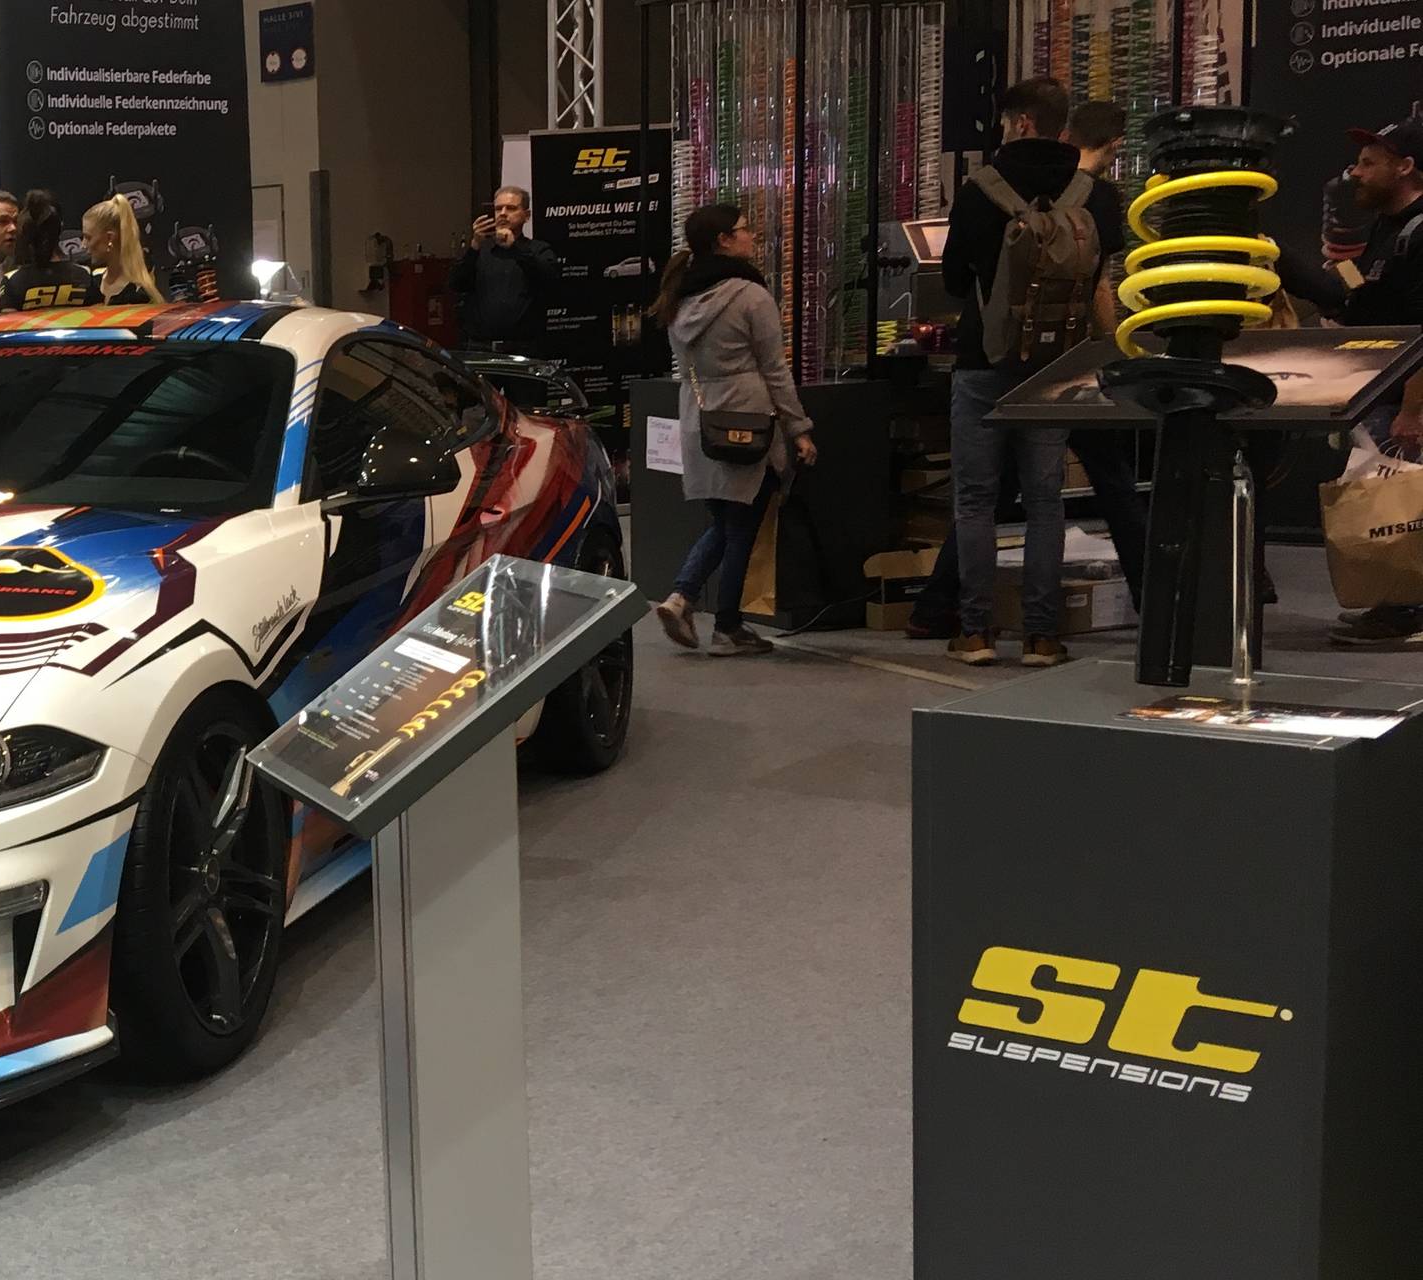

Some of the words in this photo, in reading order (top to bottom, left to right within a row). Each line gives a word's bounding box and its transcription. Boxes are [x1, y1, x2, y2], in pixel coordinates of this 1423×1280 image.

[50, 4, 116, 32] Fahrzeug
[121, 8, 199, 33] abgestimmt
[1322, 16, 1422, 38] Individuelle
[1321, 45, 1406, 68] Optionale
[47, 67, 150, 84] Individualisierbare
[152, 70, 211, 85] Federfarbe
[47, 94, 112, 109] Individuelle
[115, 95, 228, 114] Federkennzeichnung
[48, 121, 103, 139] Optionale
[106, 122, 177, 139] Federpakete
[545, 203, 611, 217] INDIVIDUELL
[614, 201, 634, 213] WIE
[1369, 523, 1406, 538] MTS
[947, 1032, 1253, 1103] SUSPENSIONS
